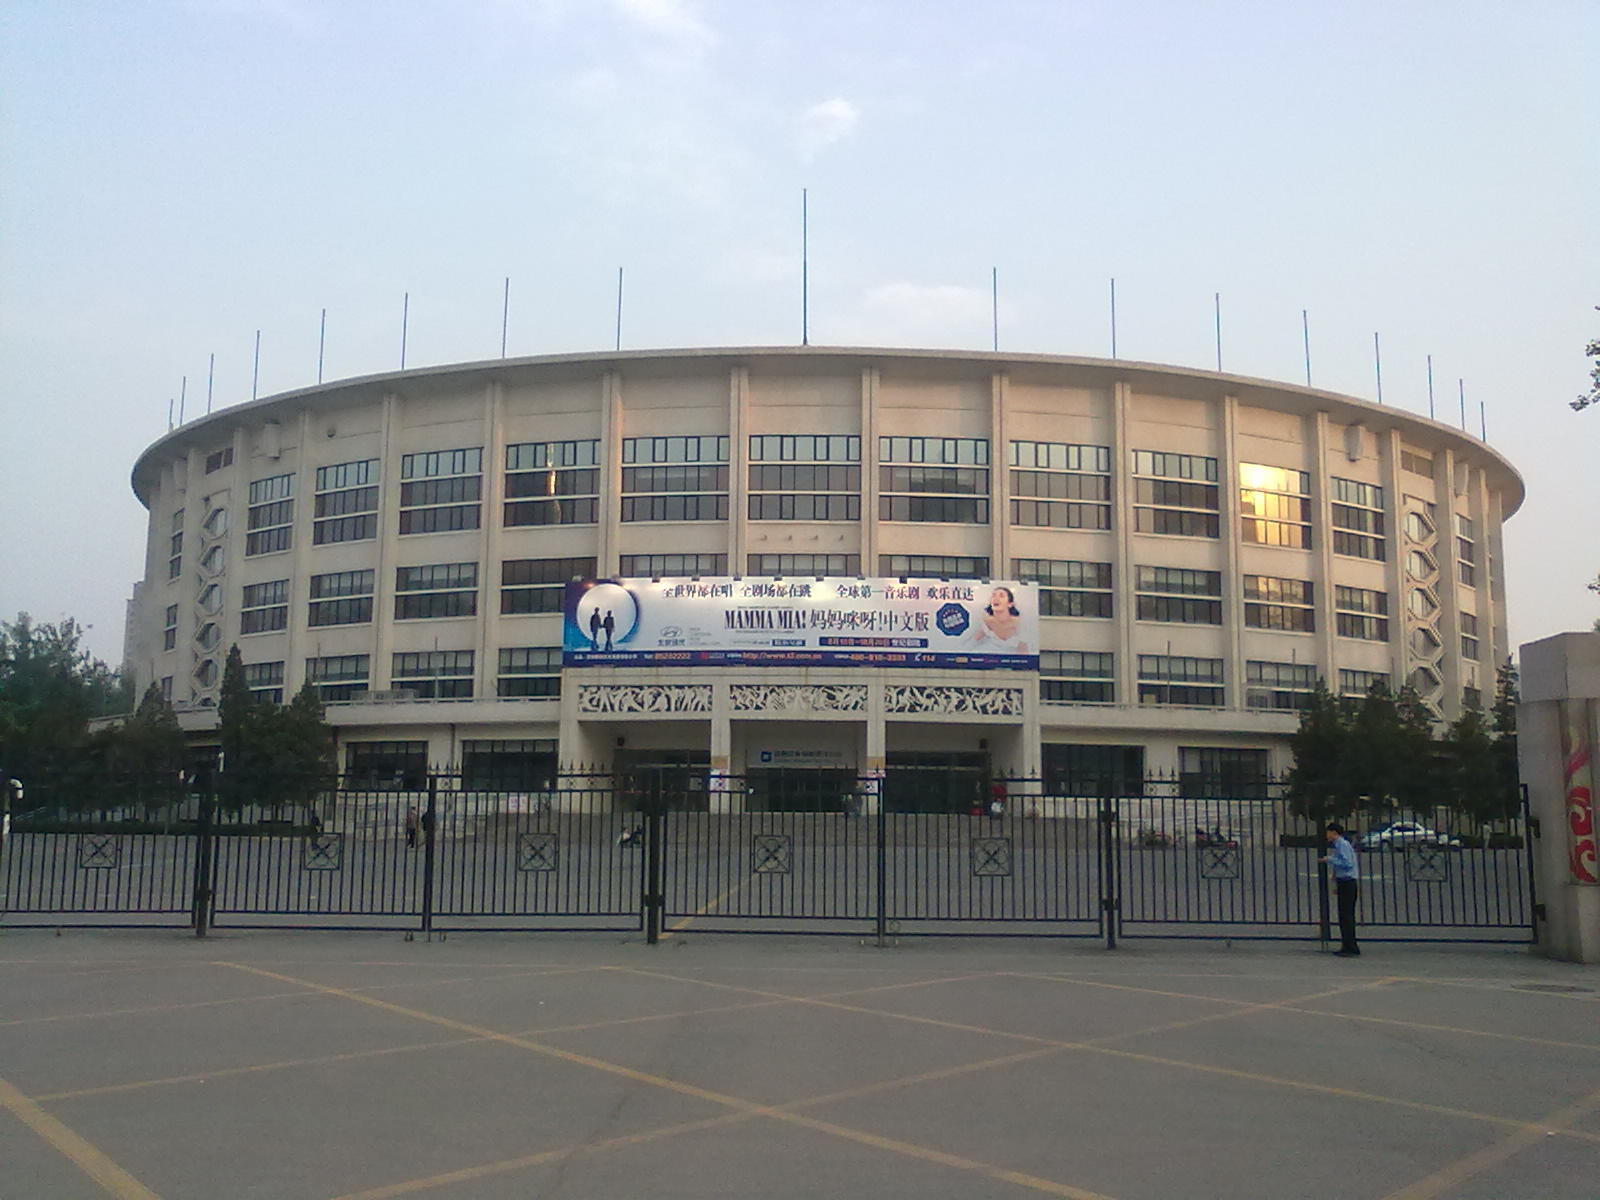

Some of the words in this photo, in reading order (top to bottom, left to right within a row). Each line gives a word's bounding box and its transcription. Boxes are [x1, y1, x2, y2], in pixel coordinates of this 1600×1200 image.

[836, 584, 920, 599] 全球第一音乐剧
[927, 585, 974, 601] 欢乐直达
[724, 610, 774, 629] MAMMA
[777, 610, 806, 629] MIA!
